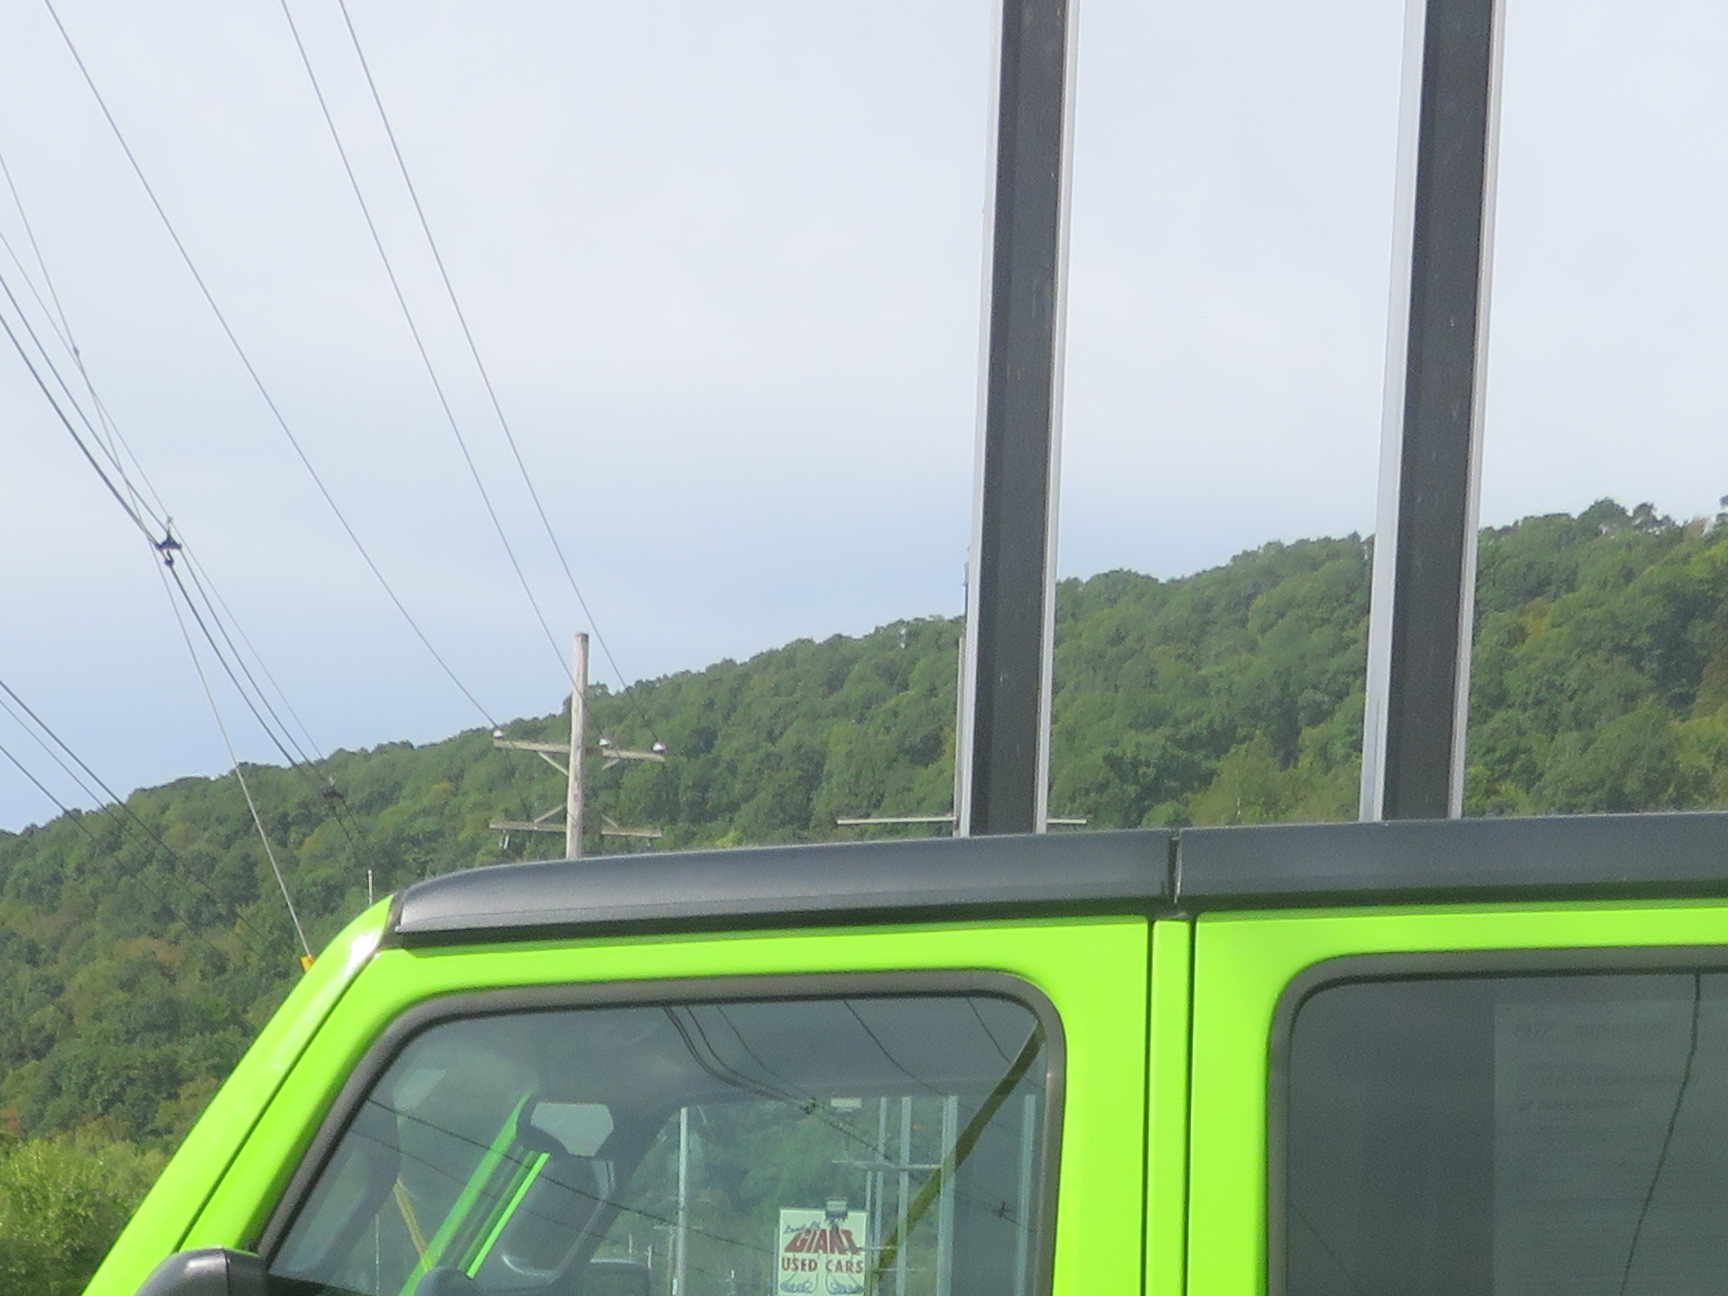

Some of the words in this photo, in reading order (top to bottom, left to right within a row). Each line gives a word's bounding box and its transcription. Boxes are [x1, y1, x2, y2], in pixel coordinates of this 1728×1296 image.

[784, 1228, 860, 1255] GIANT
[781, 1257, 818, 1272] USED
[825, 1259, 864, 1274] CARS
